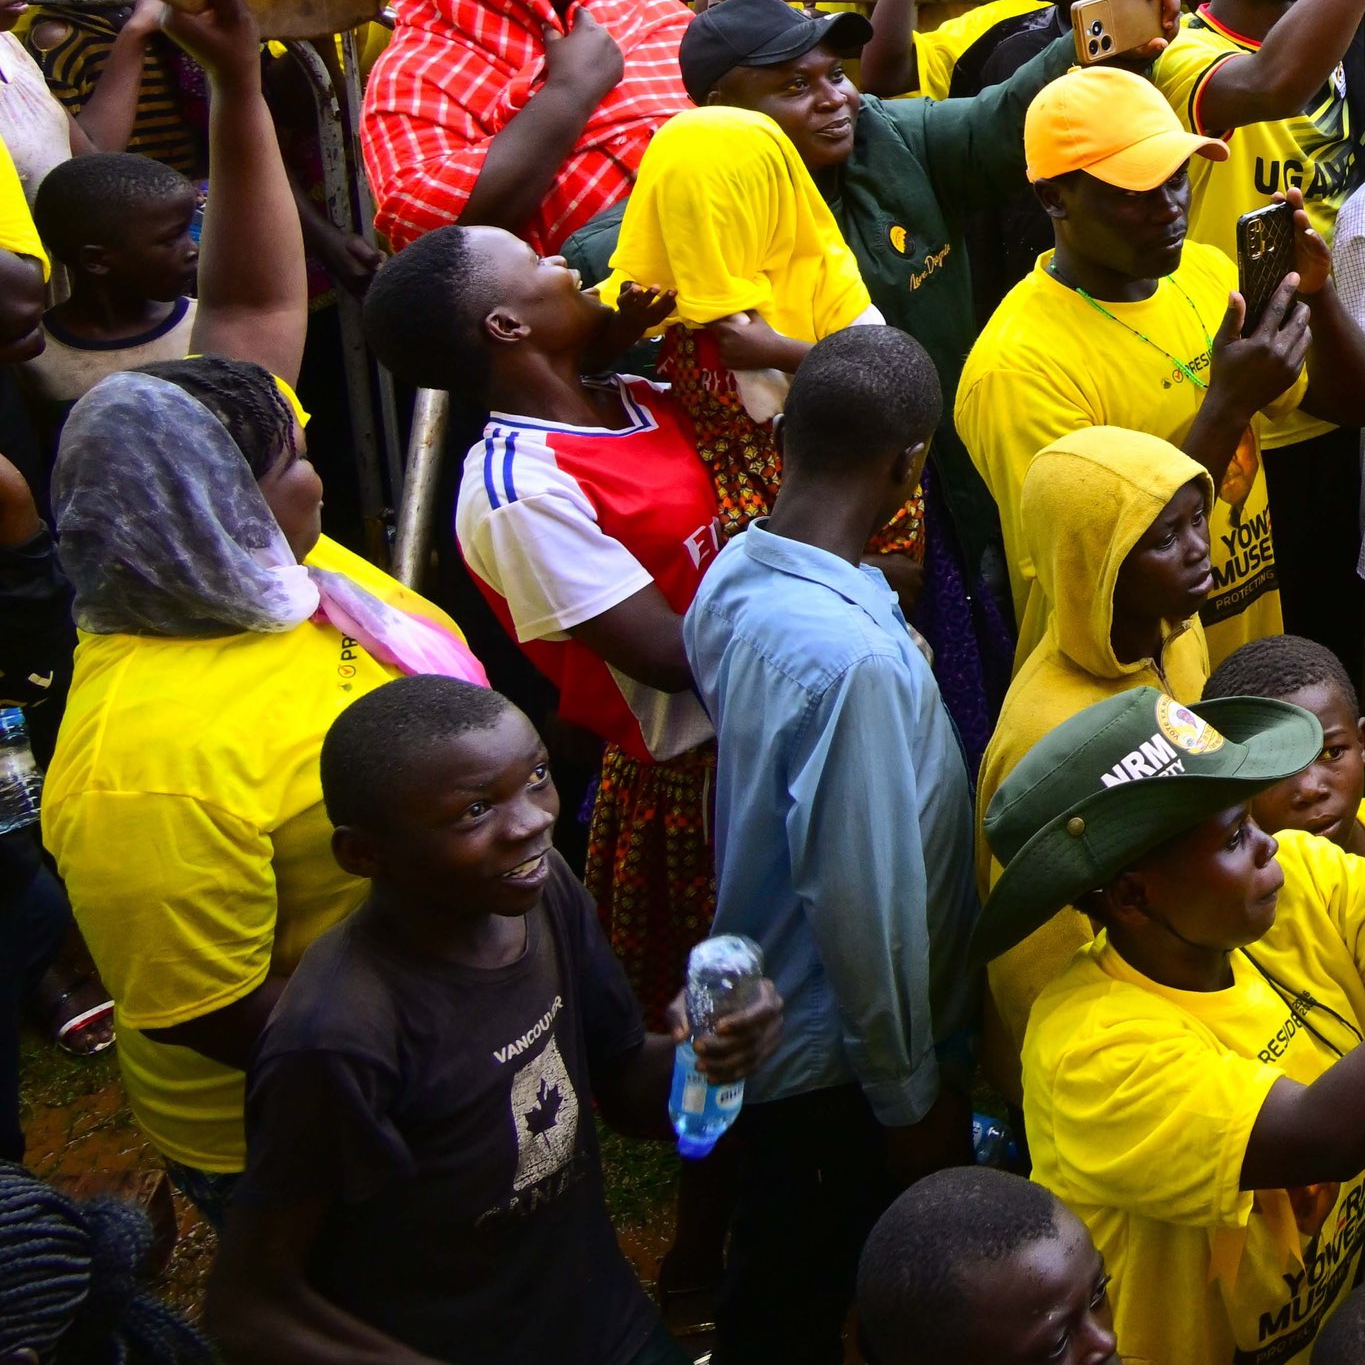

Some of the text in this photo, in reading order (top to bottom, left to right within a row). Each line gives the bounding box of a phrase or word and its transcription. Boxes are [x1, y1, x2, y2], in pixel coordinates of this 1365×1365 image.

[1209, 543, 1274, 591] MUSE
[1216, 570, 1275, 610] PROTECTING
[1101, 733, 1178, 788] NRM
